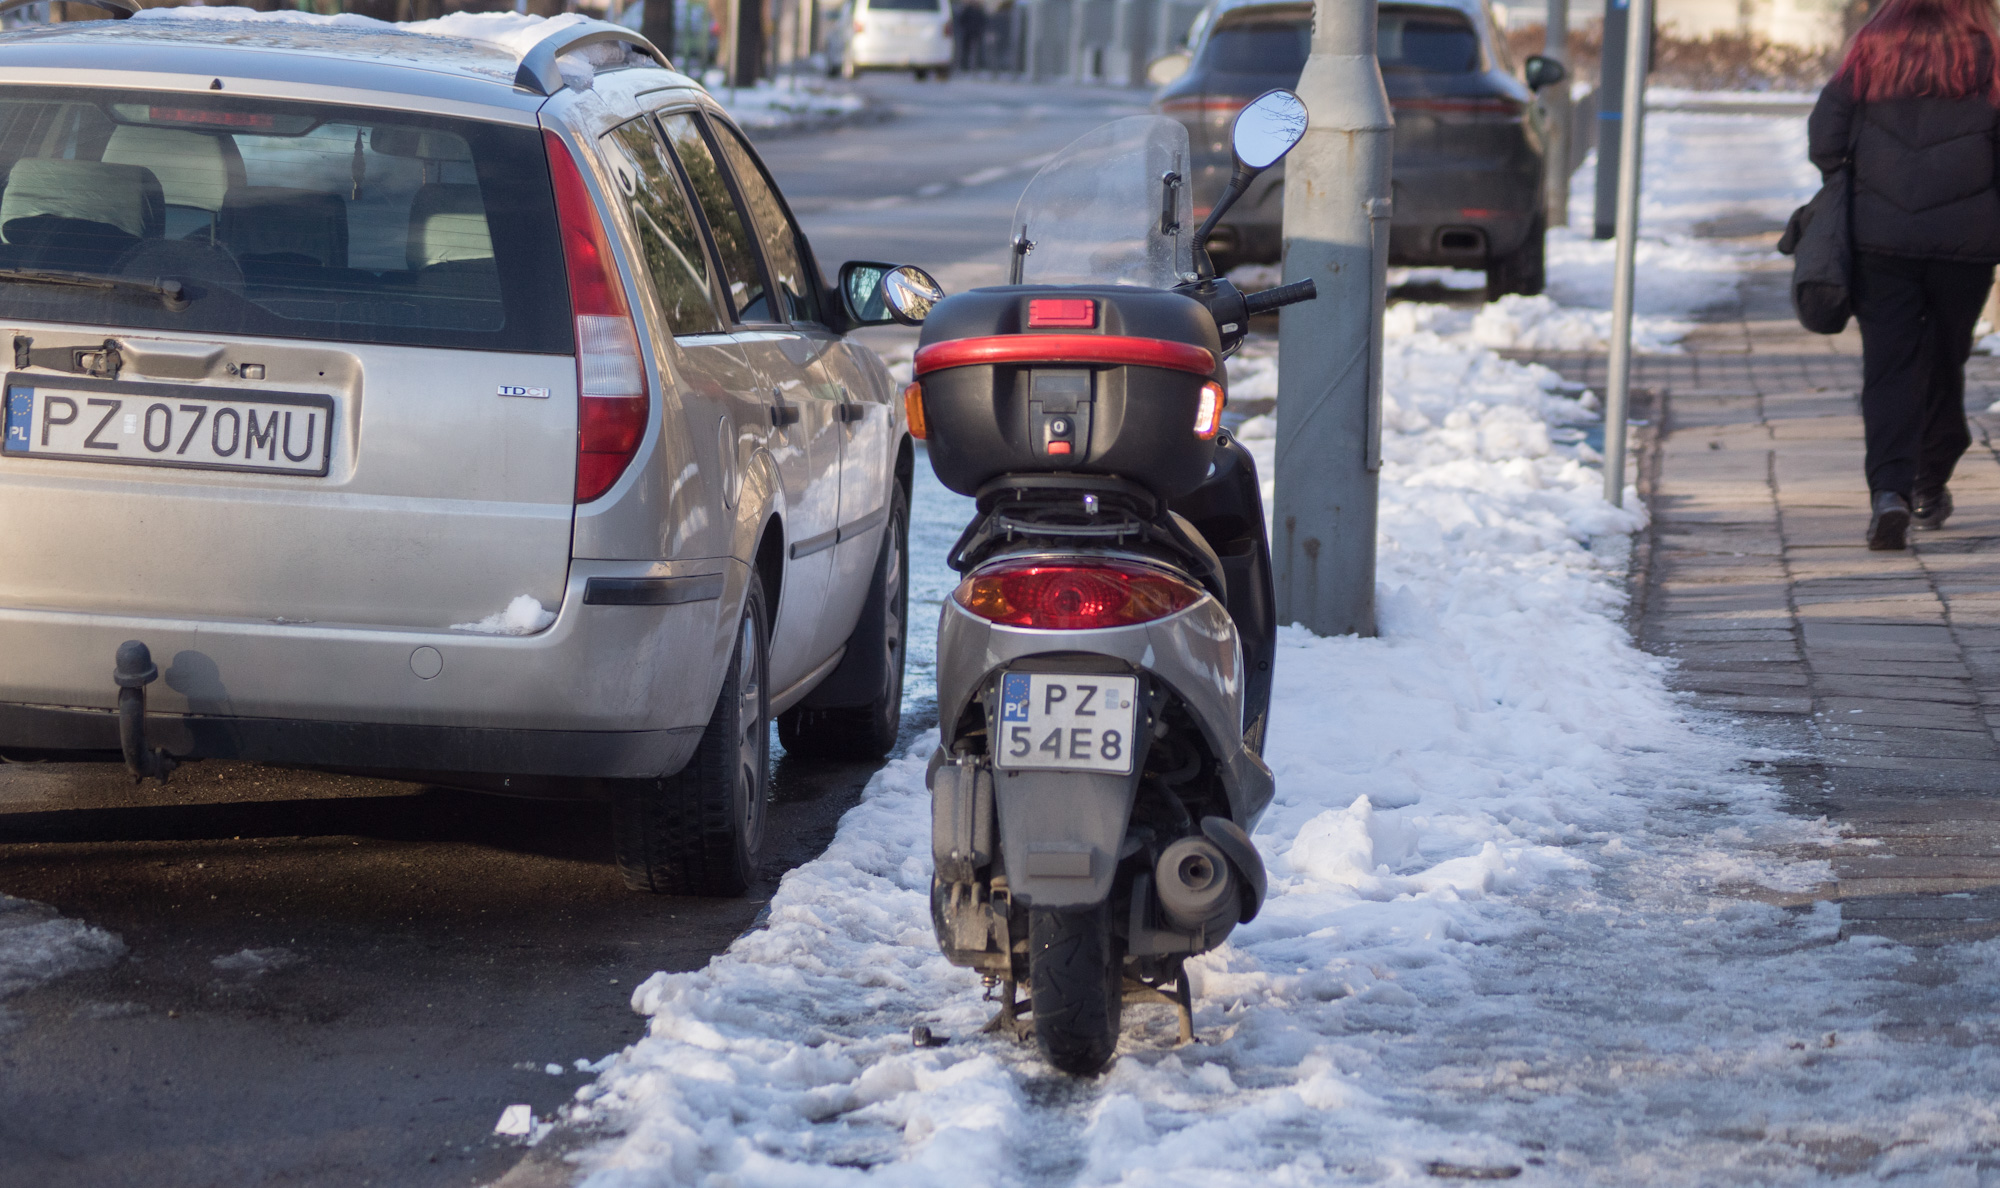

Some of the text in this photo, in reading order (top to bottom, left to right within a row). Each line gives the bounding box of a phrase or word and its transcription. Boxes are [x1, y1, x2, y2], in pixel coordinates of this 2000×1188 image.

[9, 426, 27, 441] PL
[41, 396, 315, 462] PZ 070MU
[1004, 702, 1026, 717] PL
[1045, 684, 1098, 716] PZ
[1009, 726, 1122, 760] 54E8
